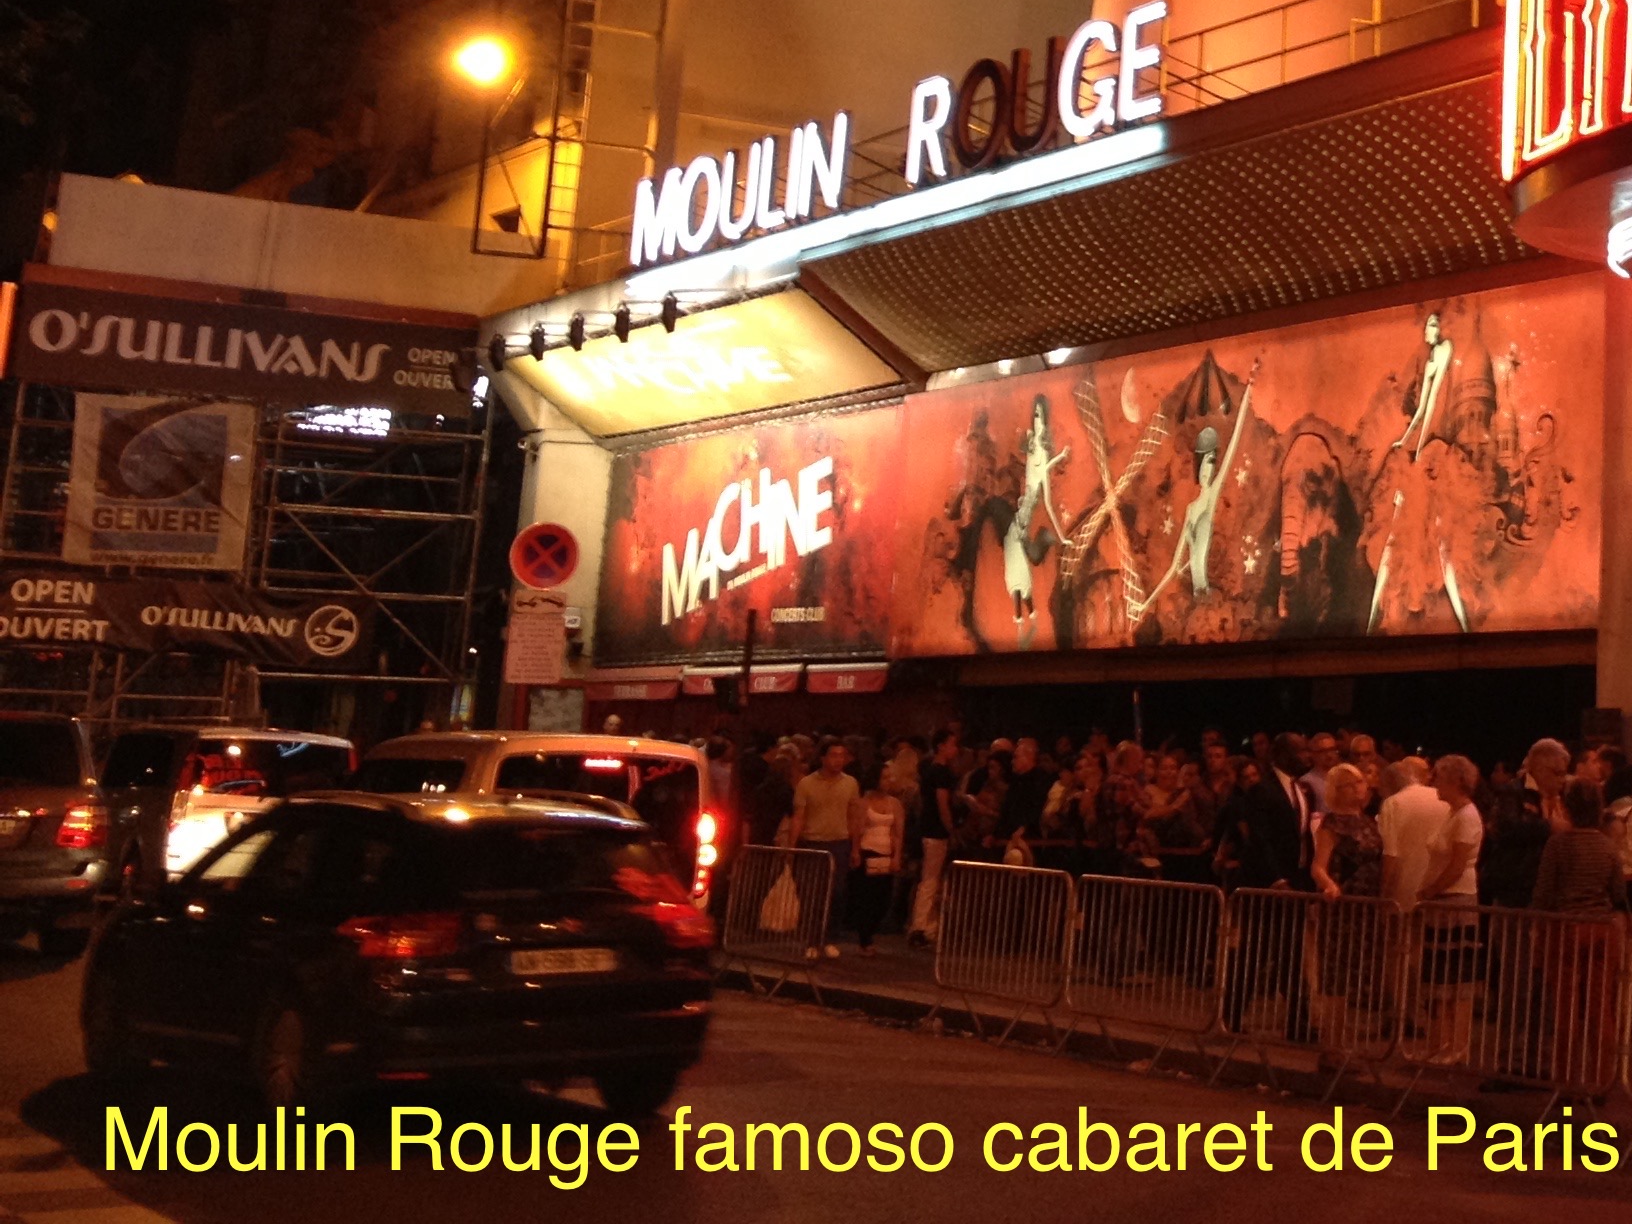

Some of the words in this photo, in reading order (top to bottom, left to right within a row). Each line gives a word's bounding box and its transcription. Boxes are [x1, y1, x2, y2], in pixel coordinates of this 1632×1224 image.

[631, 110, 849, 266] MOULIN
[29, 309, 390, 382] O'SULLIVANS
[407, 346, 458, 366] OPEN
[393, 370, 456, 391] OUVER
[661, 456, 834, 626] MACHINE
[10, 578, 95, 605] OPEN
[140, 605, 298, 639] O'SULLIVANS
